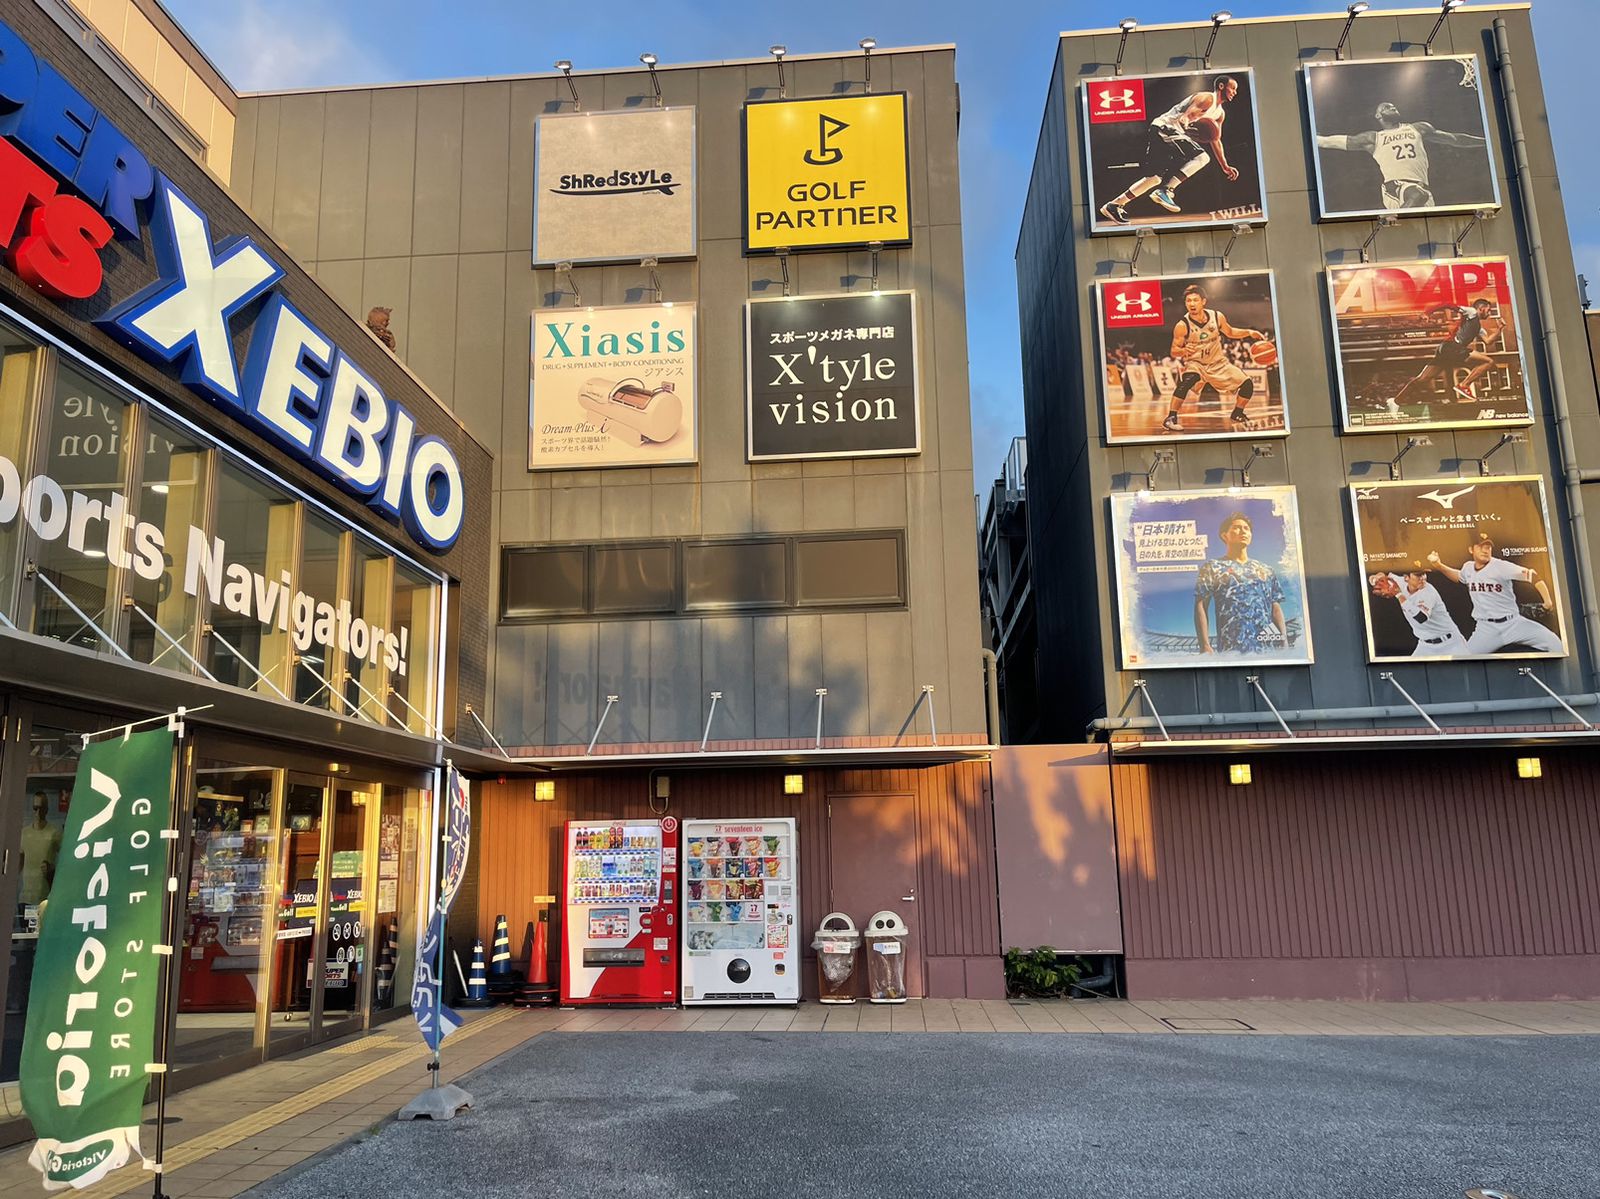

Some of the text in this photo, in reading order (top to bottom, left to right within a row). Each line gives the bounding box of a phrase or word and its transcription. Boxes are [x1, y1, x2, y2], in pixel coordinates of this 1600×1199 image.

[1382, 131, 1416, 146] LAKERS
[1392, 143, 1417, 160] 23
[787, 180, 866, 202] GOLF
[1217, 203, 1262, 220] WILL
[543, 320, 686, 359] Xiasis
[769, 326, 895, 344] スポーツメガネ専門店
[94, 168, 465, 549] XEBIO
[542, 361, 562, 370] DRUG
[566, 360, 607, 369] SUPPLEMENT
[613, 360, 632, 368] BODY
[633, 358, 685, 367] CONDITIONING
[644, 367, 684, 377] ジアシス
[769, 345, 896, 392] X'tyle
[769, 391, 898, 425] vision
[1400, 513, 1501, 524] ベースボールと生きていく。
[1501, 547, 1510, 557] 19
[183, 524, 408, 676] Navigators!
[724, 825, 753, 833] seventeen
[754, 824, 763, 832] ice
[293, 892, 315, 904] XEBIO
